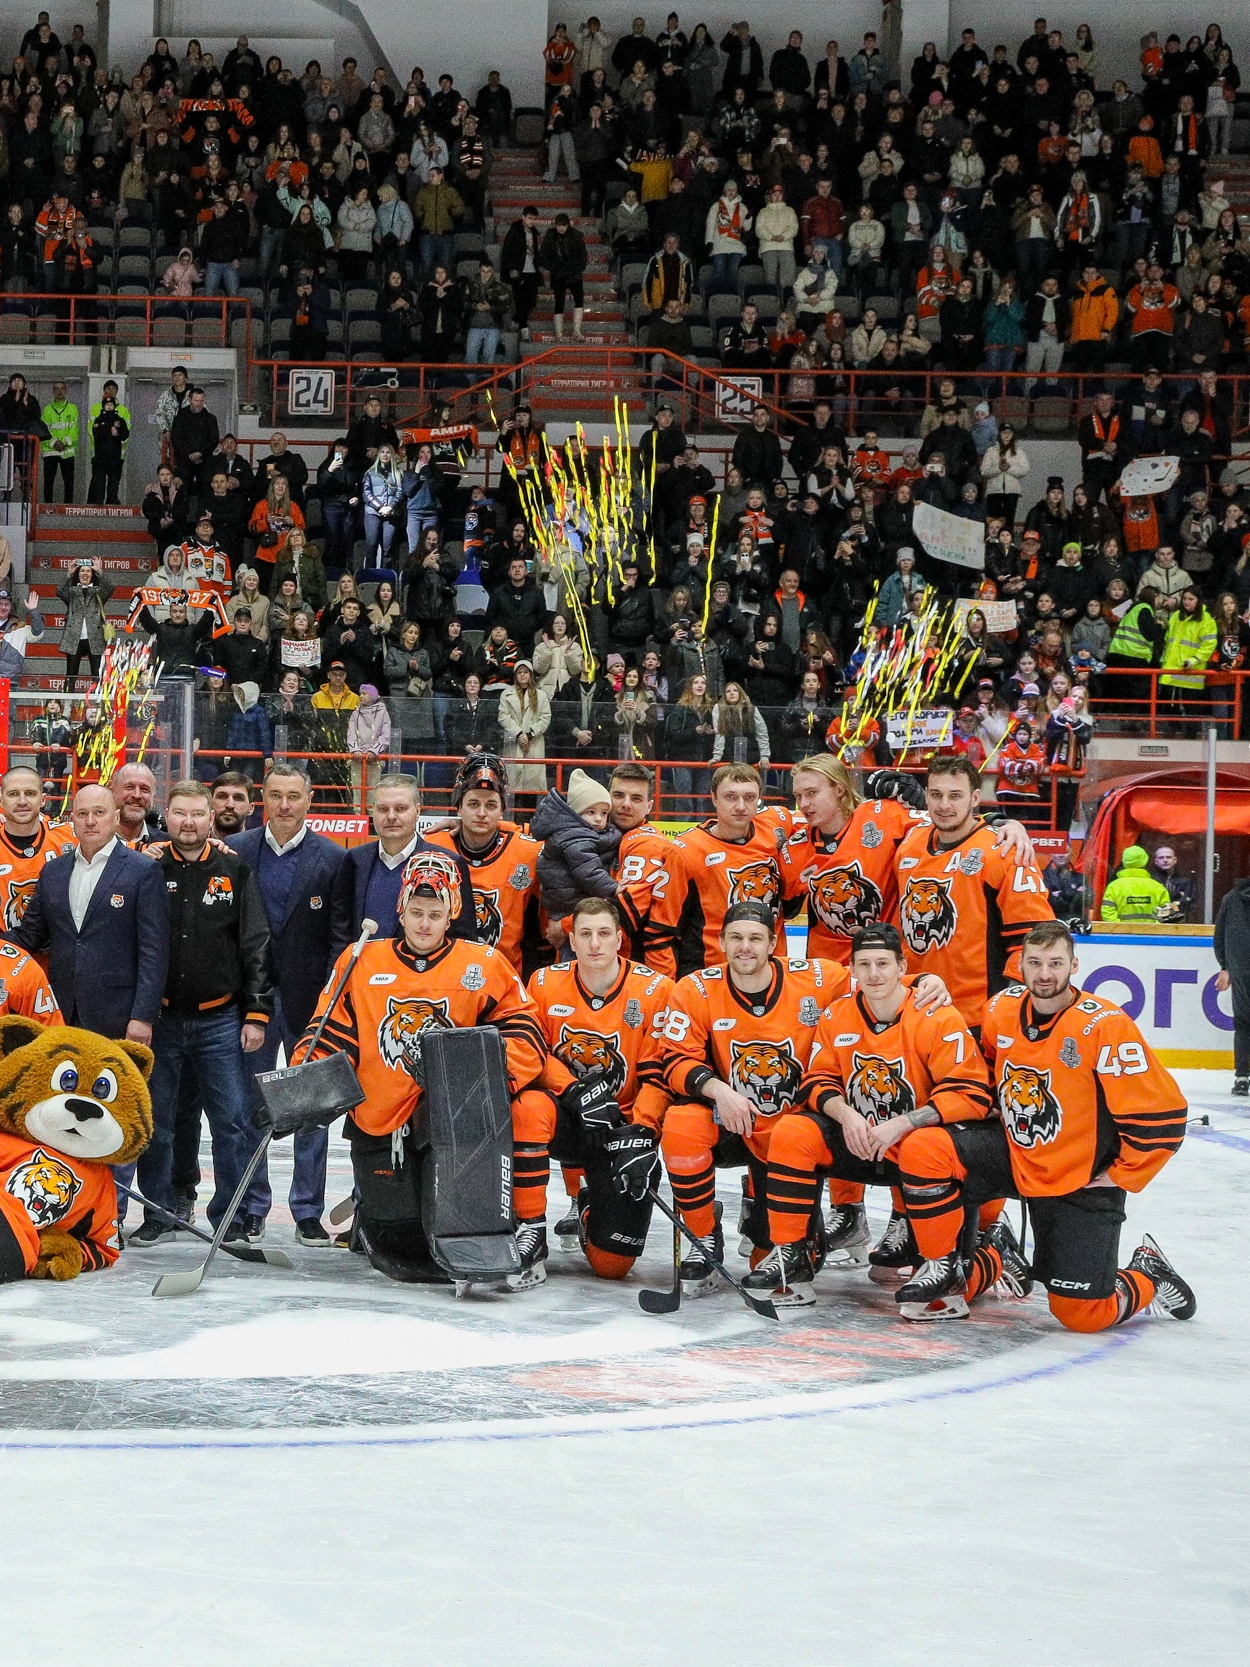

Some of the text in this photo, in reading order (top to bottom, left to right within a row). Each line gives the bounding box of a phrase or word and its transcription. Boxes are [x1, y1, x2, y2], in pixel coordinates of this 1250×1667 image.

[551, 379, 590, 388] ТЕРРИТОРИЯ
[295, 377, 329, 408] 24
[65, 507, 133, 517] ТЕРРИТОРИЯ ТИГРОВ
[104, 559, 130, 570] ТИГРОВ
[142, 589, 210, 605] 19 57
[304, 819, 367, 833] FONBET
[1031, 838, 1065, 847] PBET
[943, 851, 962, 873] A
[621, 855, 669, 900] 82
[1096, 1042, 1150, 1078] 49
[1050, 1278, 1092, 1292] CCM
